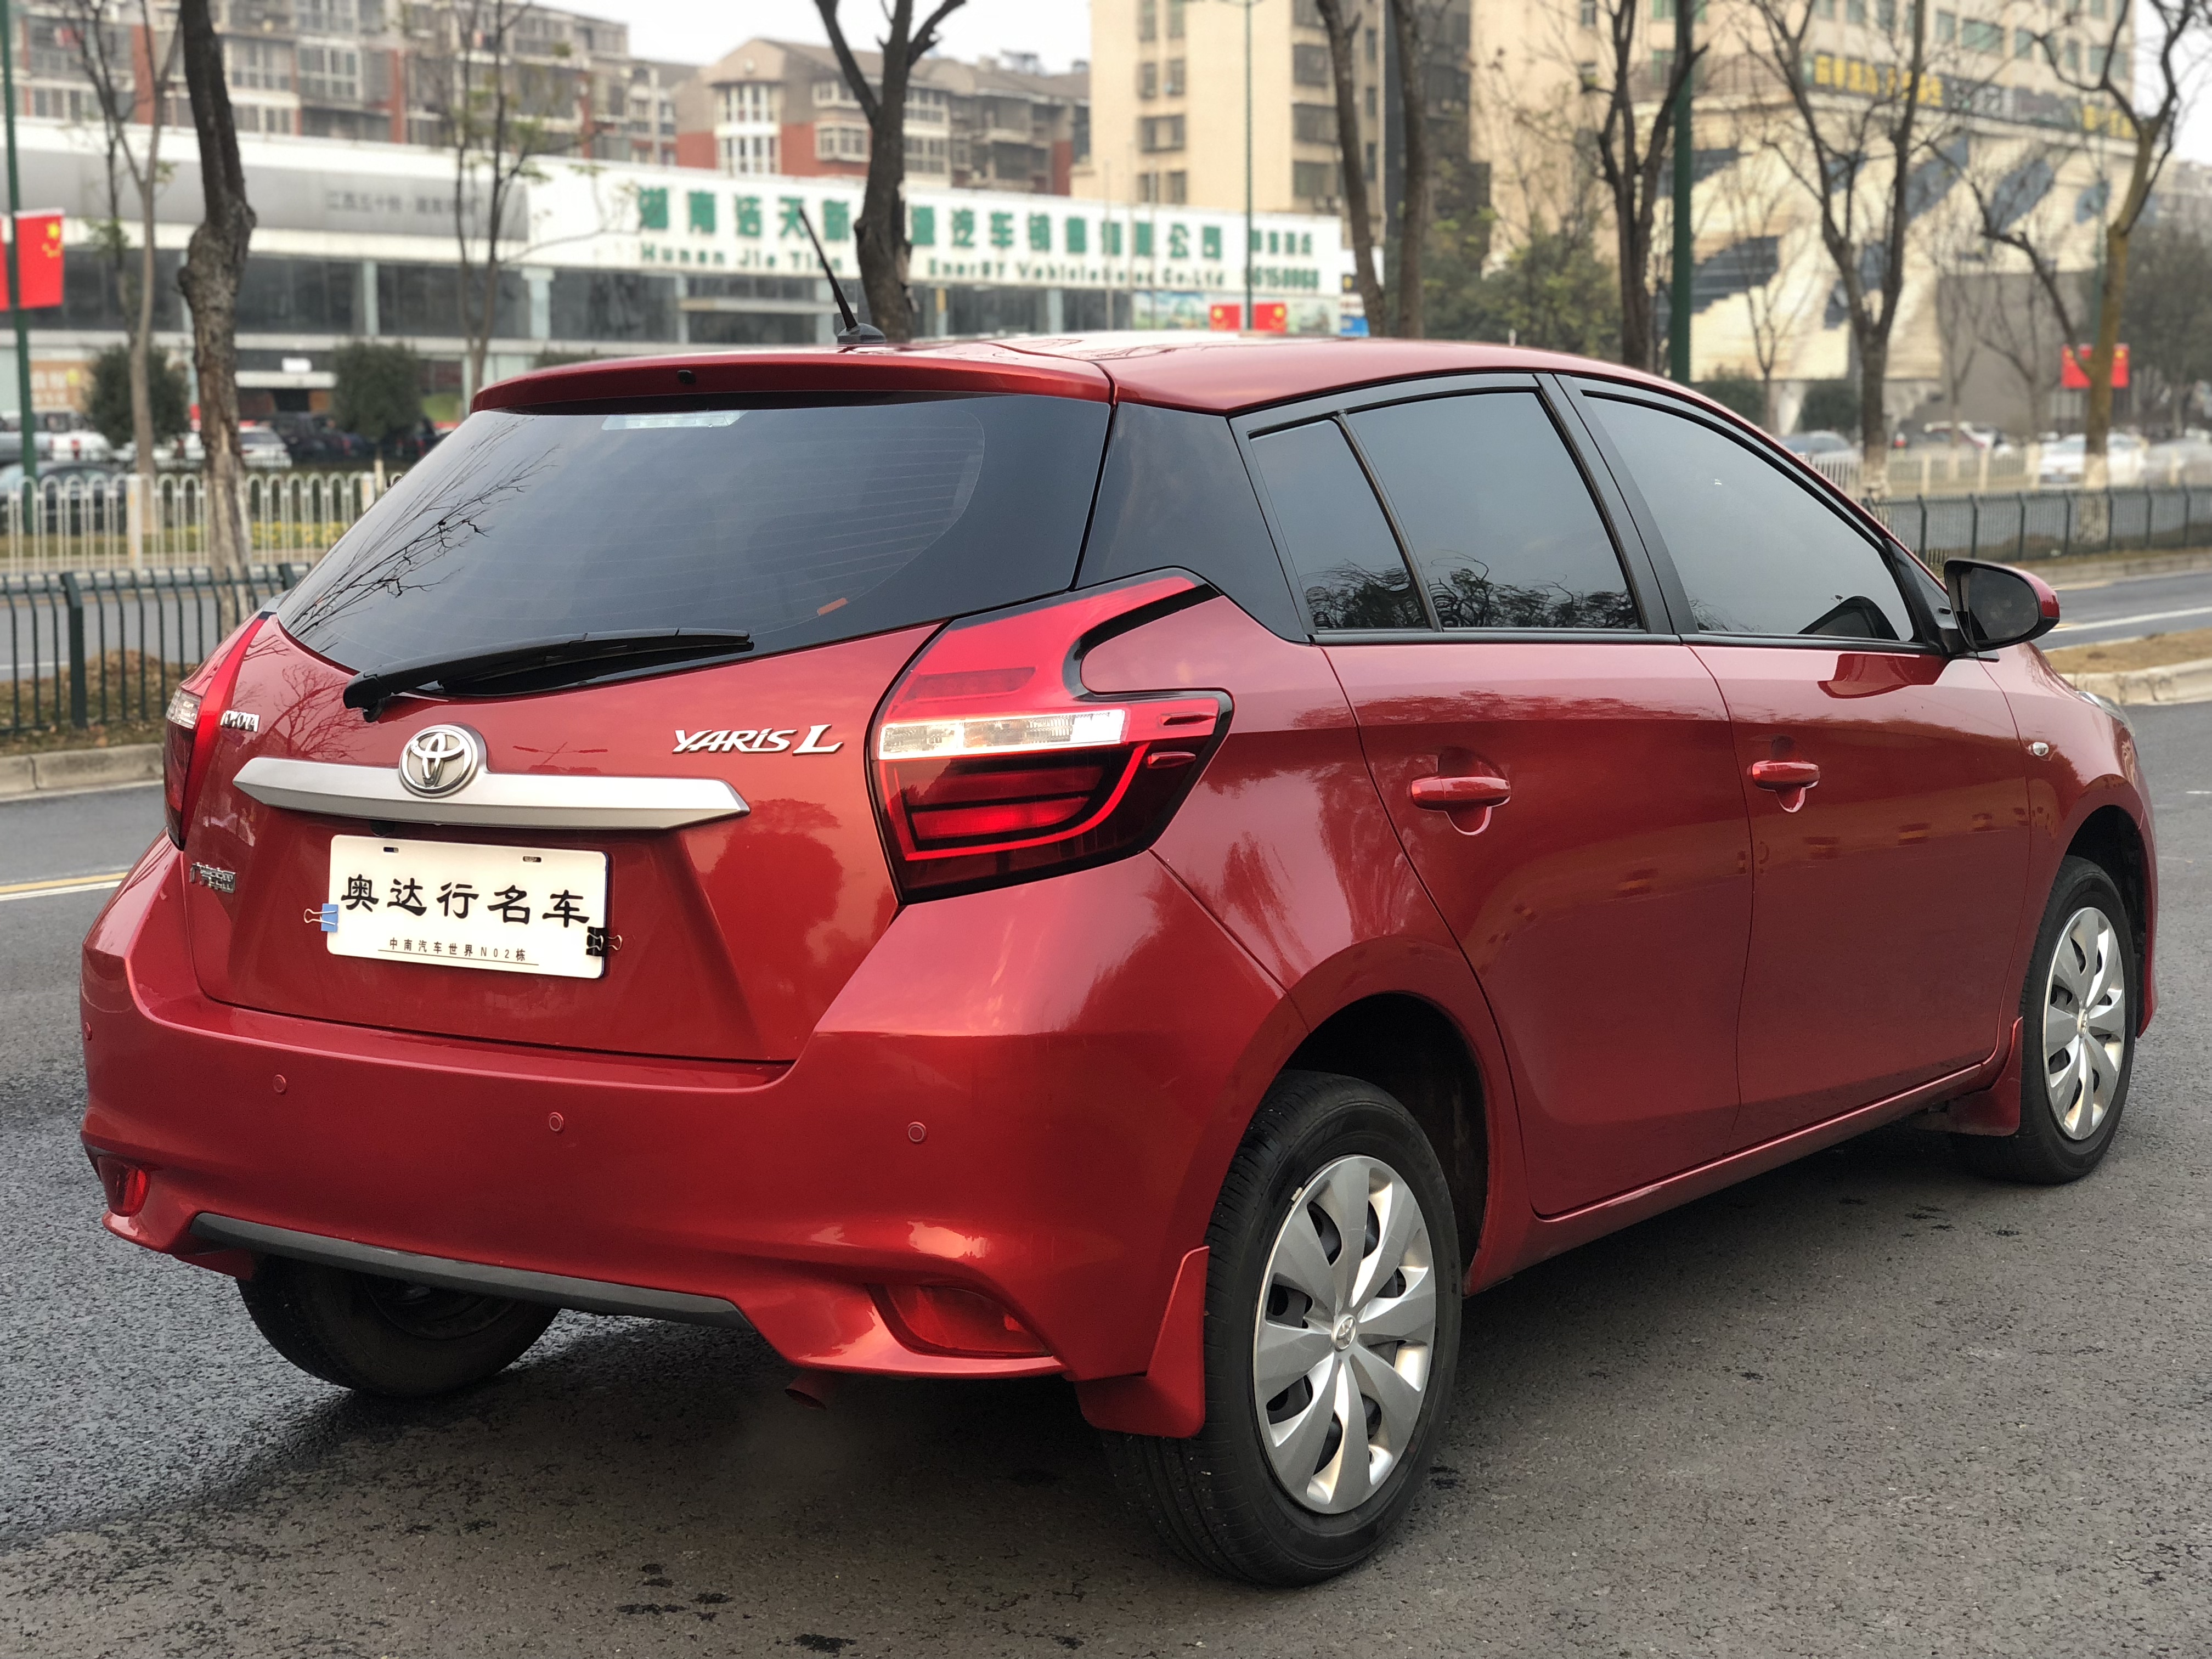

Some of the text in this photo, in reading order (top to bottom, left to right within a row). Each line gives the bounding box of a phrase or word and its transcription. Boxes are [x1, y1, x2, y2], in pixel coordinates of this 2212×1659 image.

[792, 724, 844, 757] L
[340, 873, 590, 928] 奥达行名车
